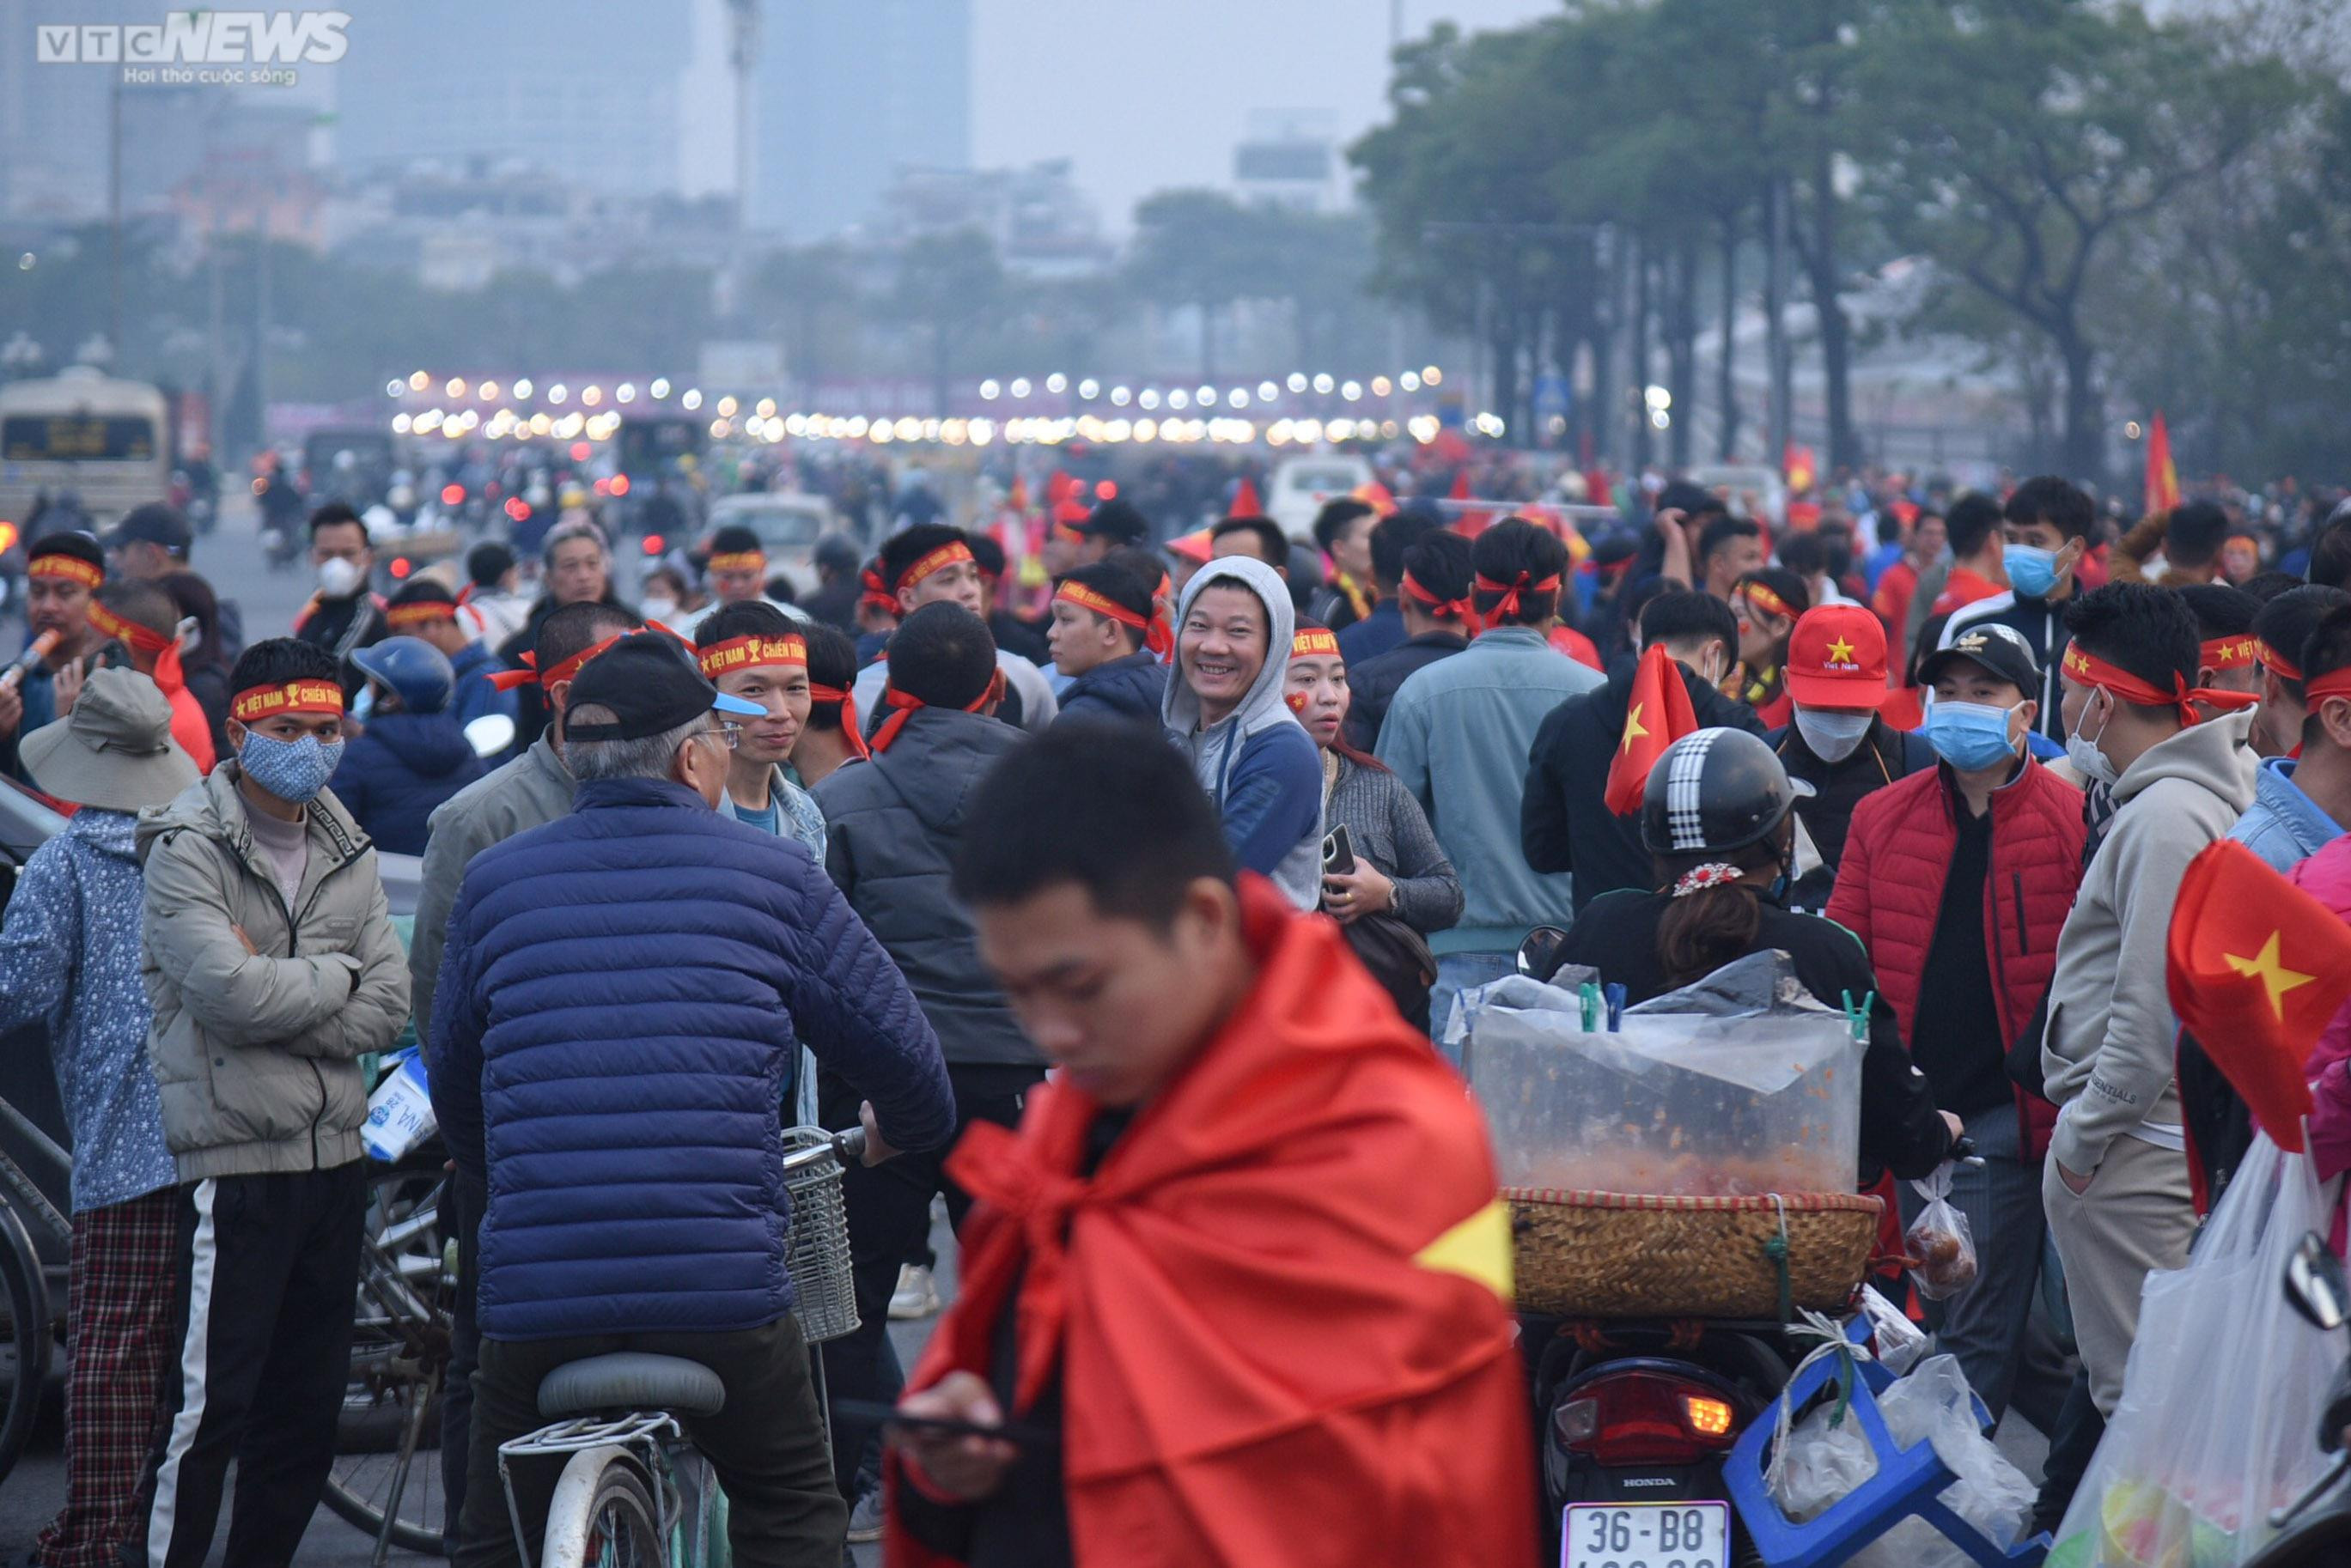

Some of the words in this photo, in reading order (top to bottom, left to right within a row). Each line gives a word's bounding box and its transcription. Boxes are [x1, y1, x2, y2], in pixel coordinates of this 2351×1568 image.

[709, 650, 725, 671] VIỆT
[726, 646, 746, 665] NAM
[763, 637, 789, 658] CHIẾN
[2237, 639, 2253, 659] VIỆT
[247, 693, 262, 714] VIỆT
[263, 690, 284, 709] NAM
[301, 683, 326, 702] CHIẾN
[1623, 1478, 1676, 1487] HONDA
[1587, 1509, 1703, 1553] 36-B8
